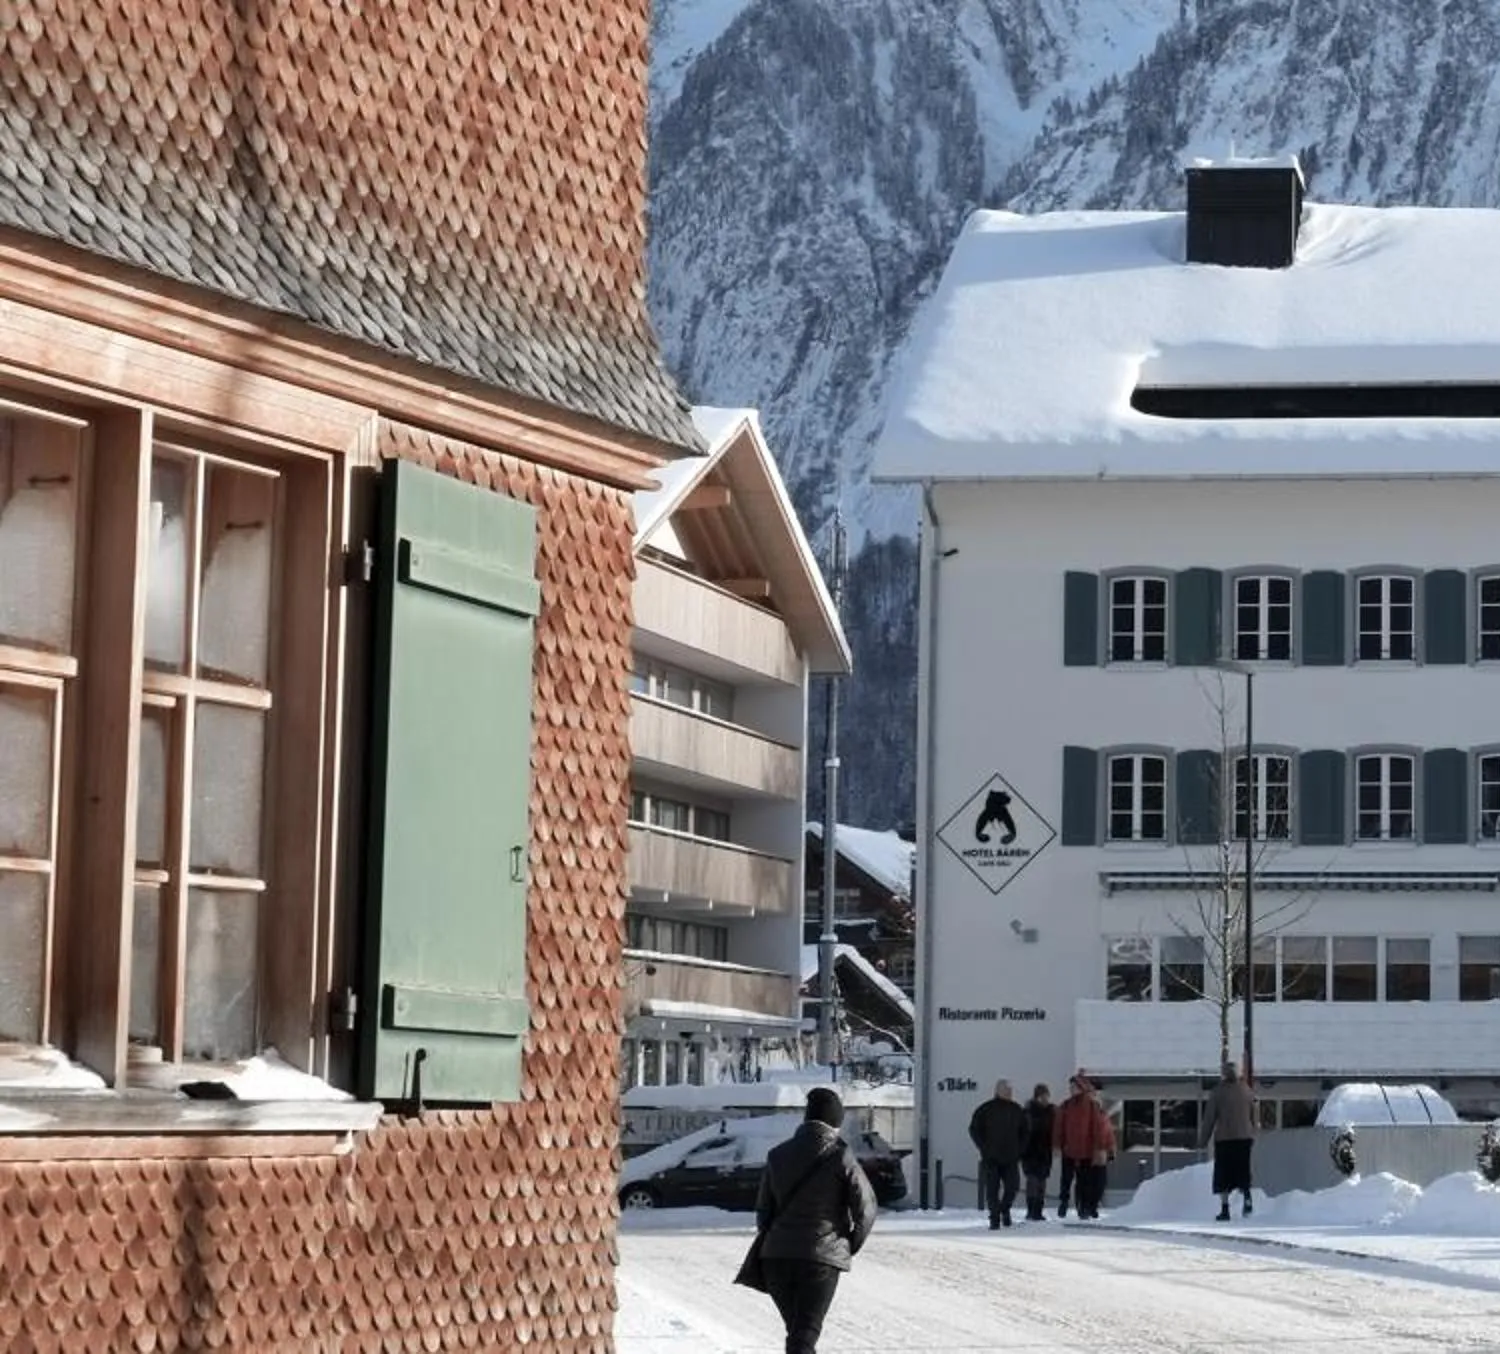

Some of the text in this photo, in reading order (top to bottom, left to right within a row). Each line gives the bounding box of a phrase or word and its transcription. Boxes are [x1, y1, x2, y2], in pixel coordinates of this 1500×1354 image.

[962, 848, 993, 857] HOTEL
[939, 1007, 1046, 1020] Ristorante Pizzeria
